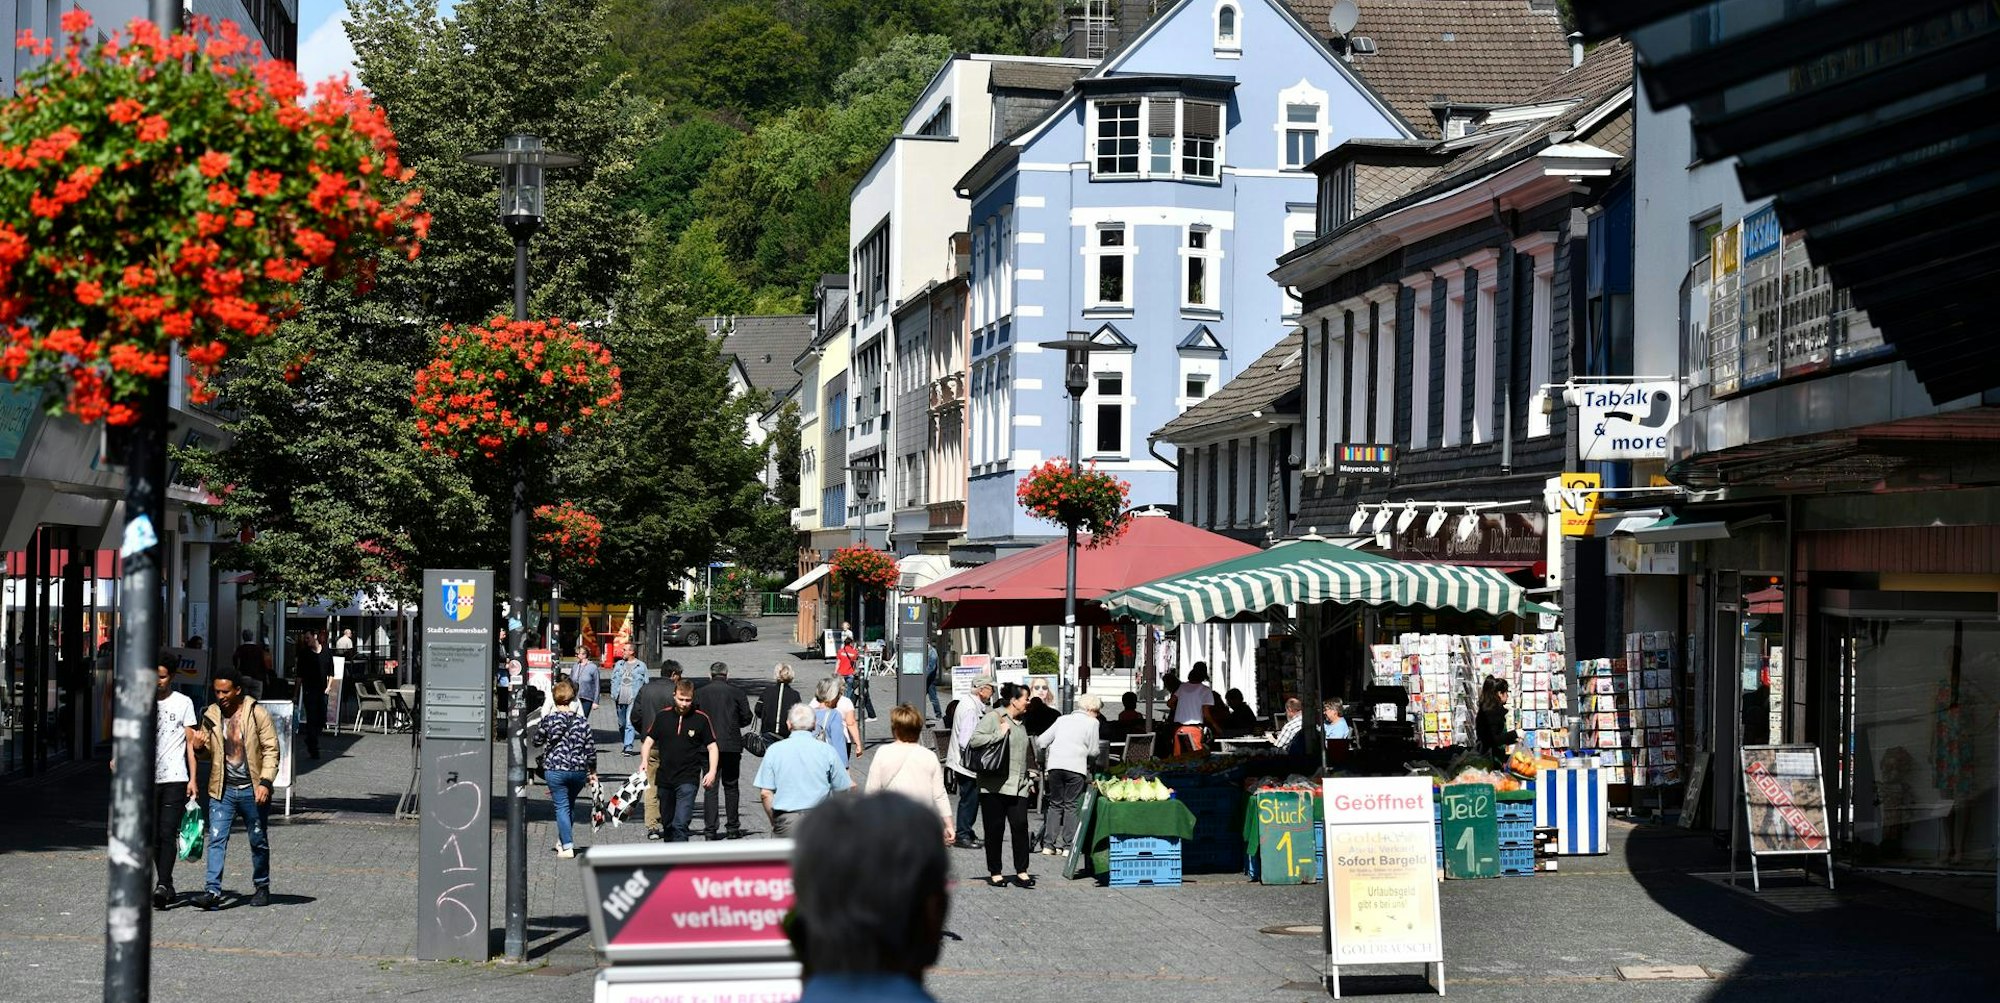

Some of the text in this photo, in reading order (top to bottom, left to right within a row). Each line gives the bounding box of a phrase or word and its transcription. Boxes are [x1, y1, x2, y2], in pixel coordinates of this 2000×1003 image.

[1585, 389, 1648, 407] Tabak
[1594, 423, 1606, 436] &
[1612, 436, 1666, 450] more
[1339, 465, 1380, 474] Mayersche
[427, 626, 488, 634] Stadt Gummersbach
[1335, 794, 1424, 811] Geöffnet
[1445, 795, 1488, 821] Teil
[1752, 766, 1818, 842] REDUZIERT
[1259, 798, 1307, 824] Stück
[1338, 855, 1427, 868] Sofort Bargeld
[602, 868, 651, 922] Hier
[691, 876, 795, 902] Vertrags
[1368, 885, 1416, 899] Urlaubsgeld
[1341, 943, 1432, 956] GOLDRAUSCH
